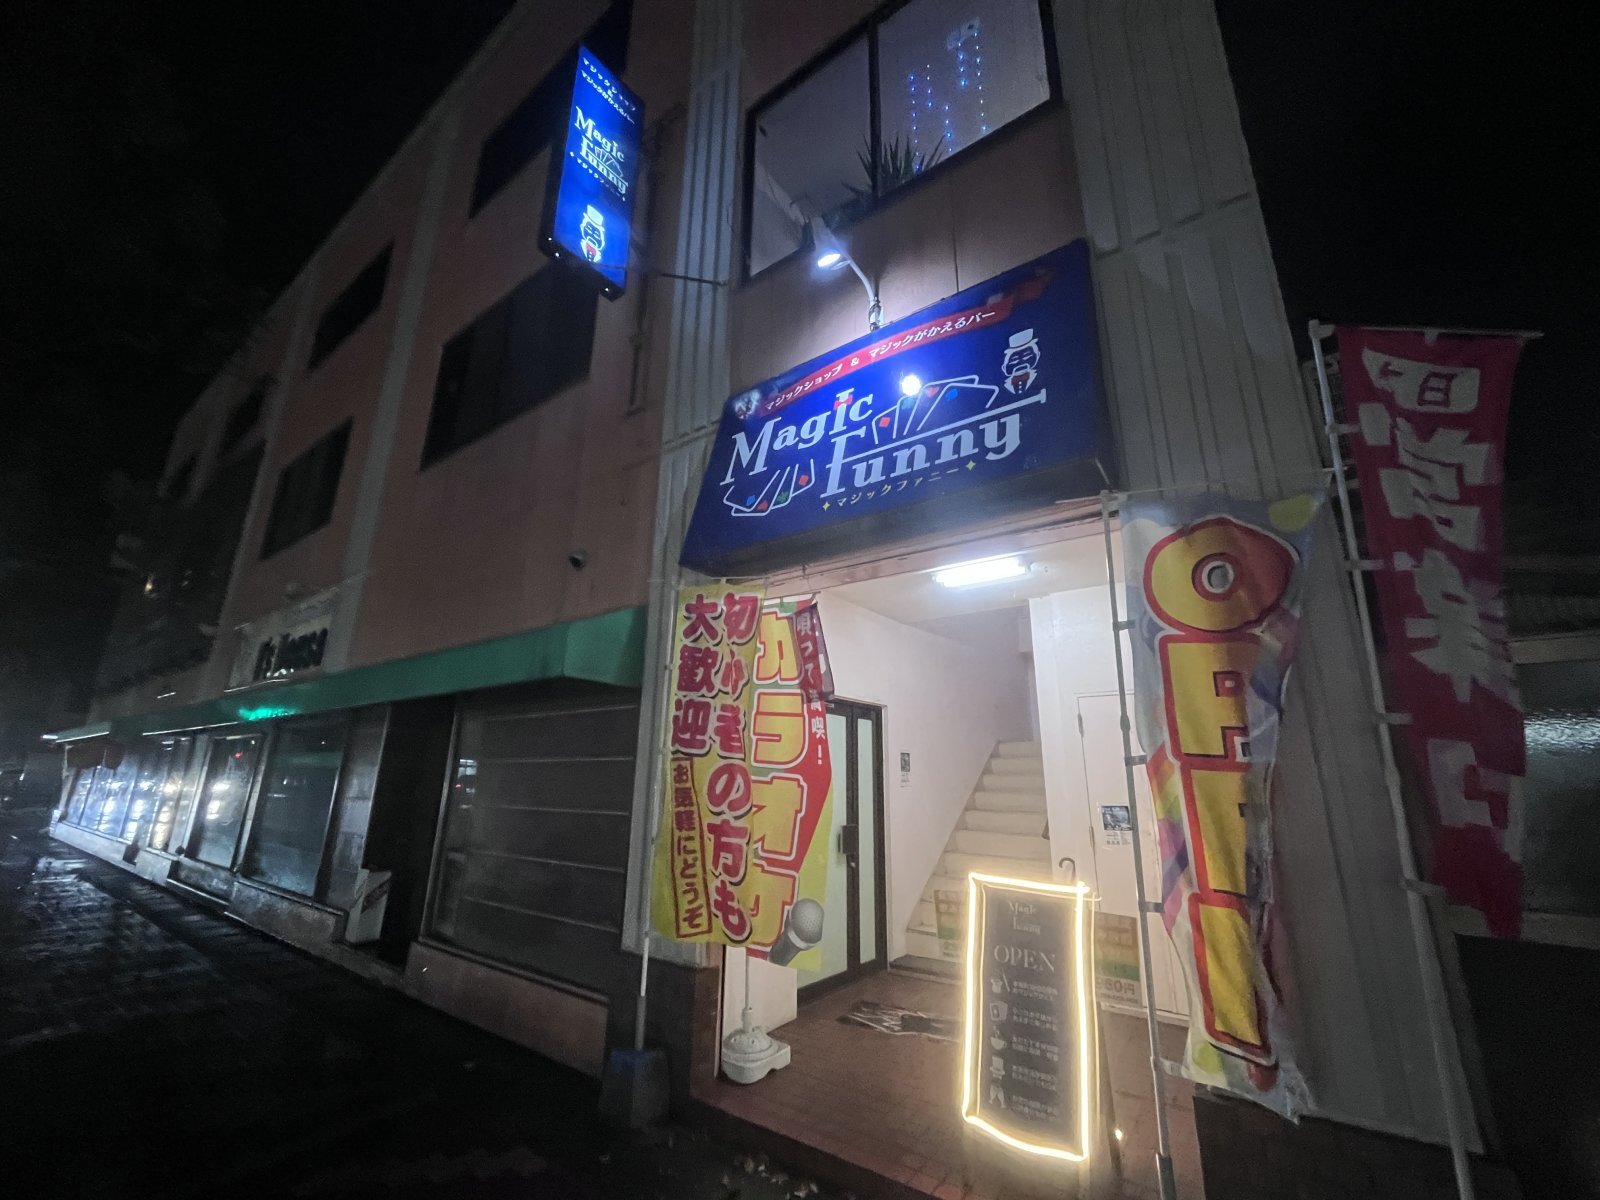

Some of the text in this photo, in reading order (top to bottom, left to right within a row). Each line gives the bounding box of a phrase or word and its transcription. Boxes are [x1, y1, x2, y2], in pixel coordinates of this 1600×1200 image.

[574, 105, 625, 162] Magic
[580, 136, 629, 195] Funny
[765, 312, 996, 410] マジックショップ & マジックがかえるバー
[719, 387, 874, 486] Magic
[820, 389, 1046, 499] Funny
[837, 468, 959, 507] マジックファニー
[672, 593, 720, 751] 大歓迎
[749, 609, 808, 948] カラオケ
[994, 944, 1055, 973] OPEN
